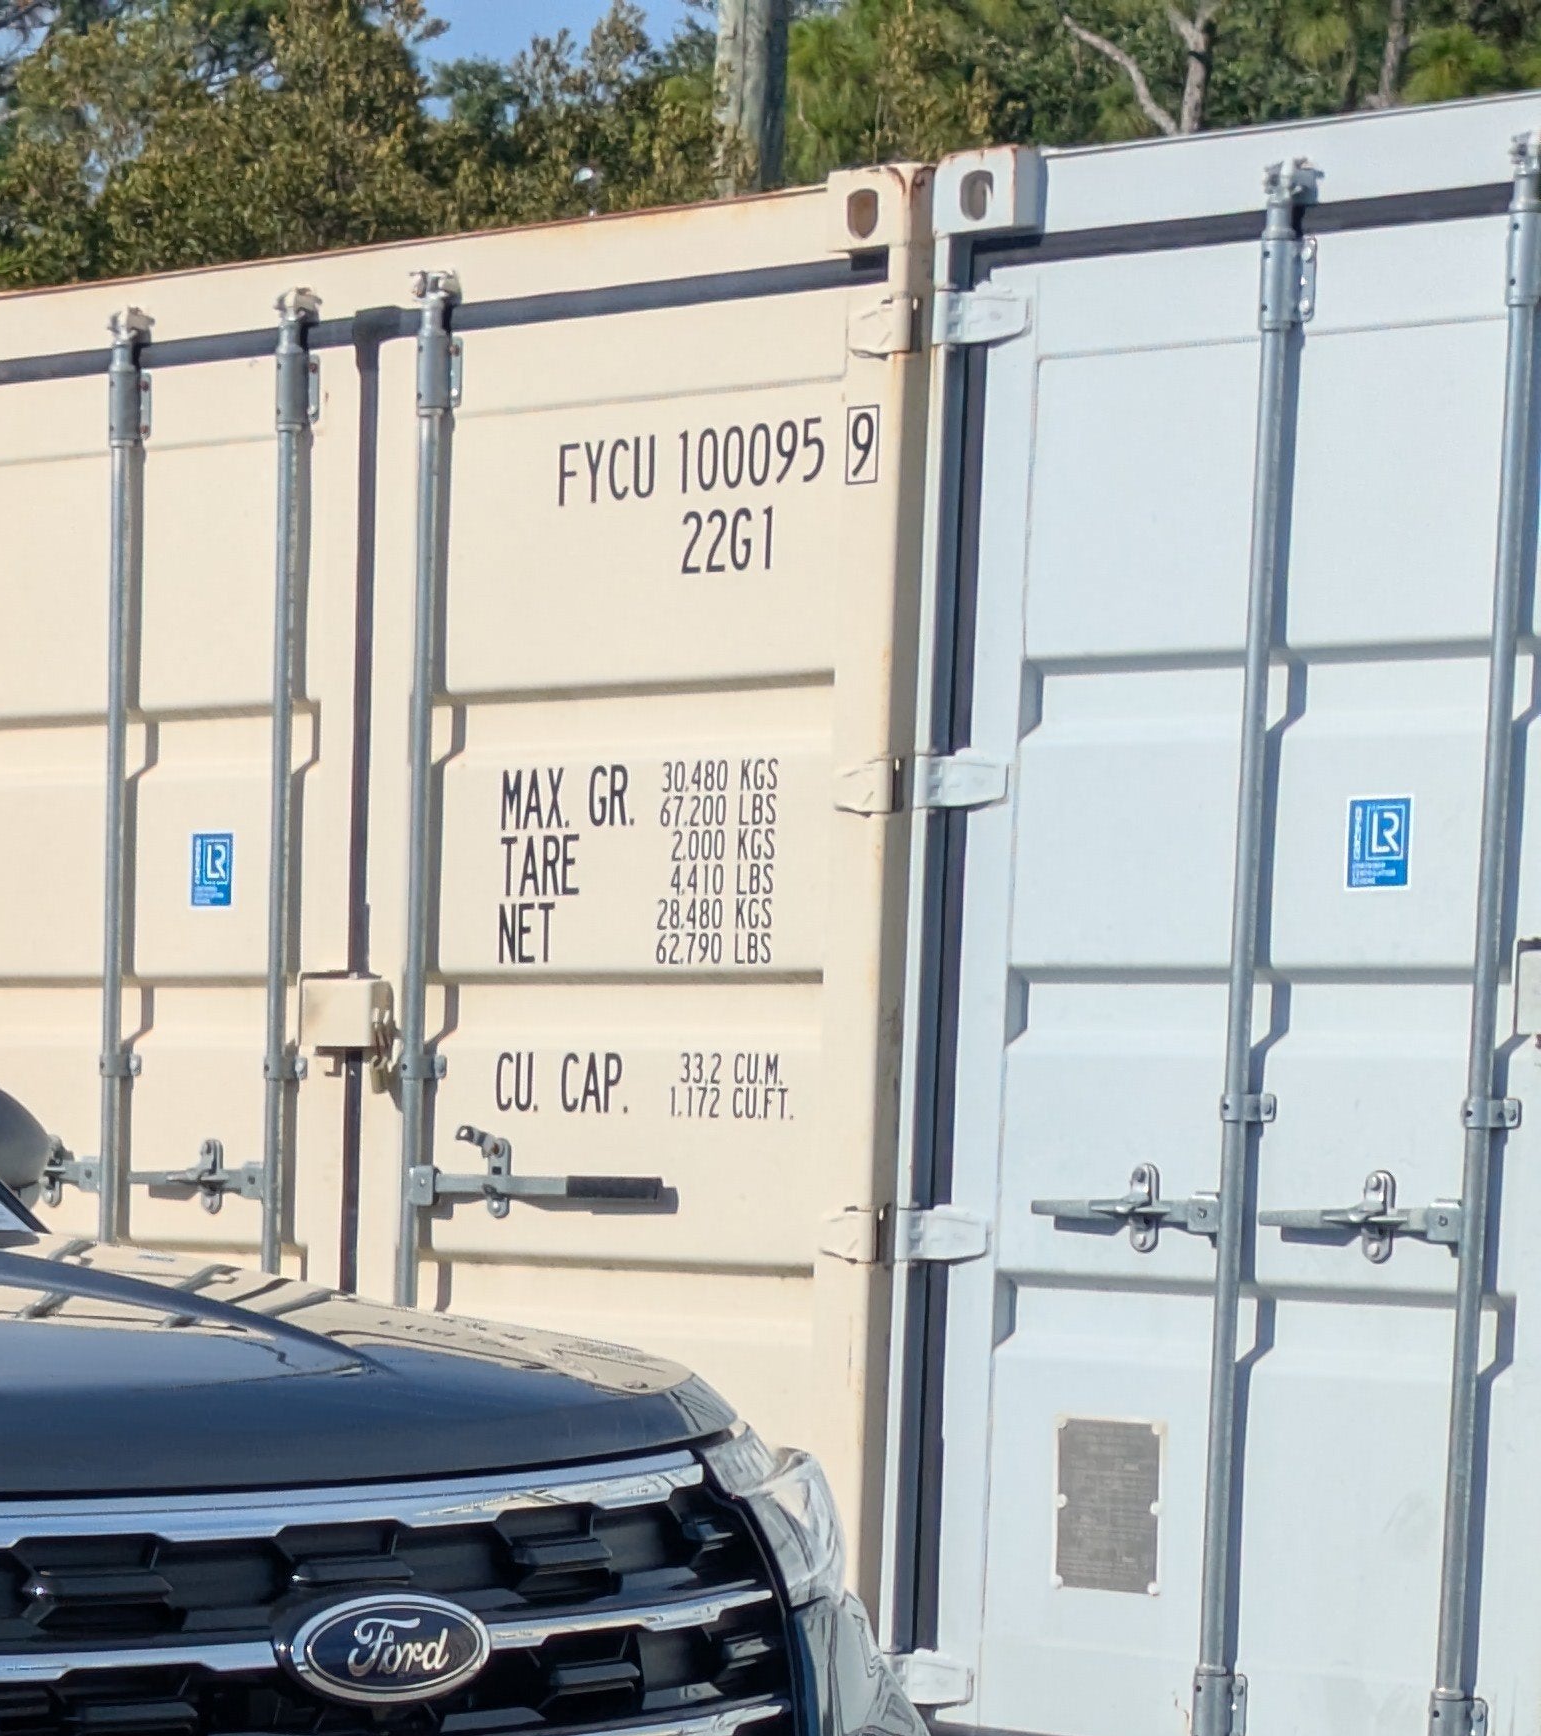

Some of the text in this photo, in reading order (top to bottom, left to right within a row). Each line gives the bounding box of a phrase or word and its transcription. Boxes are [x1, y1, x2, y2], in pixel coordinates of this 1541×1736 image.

[558, 412, 874, 507] FYCU 100095 9
[681, 505, 773, 574] 22G1
[500, 764, 635, 831] MAX. GR.
[740, 759, 779, 791] KGS
[738, 793, 777, 826] LBS
[1371, 811, 1400, 853] LR
[500, 833, 580, 898] TARE
[737, 828, 775, 861] KGS
[736, 863, 774, 896] LBS
[498, 901, 556, 964] NET
[735, 897, 772, 930] KGS
[734, 932, 771, 965] LBS
[495, 1051, 629, 1114] CU. CAP.
[348, 1617, 450, 1677] Ford
